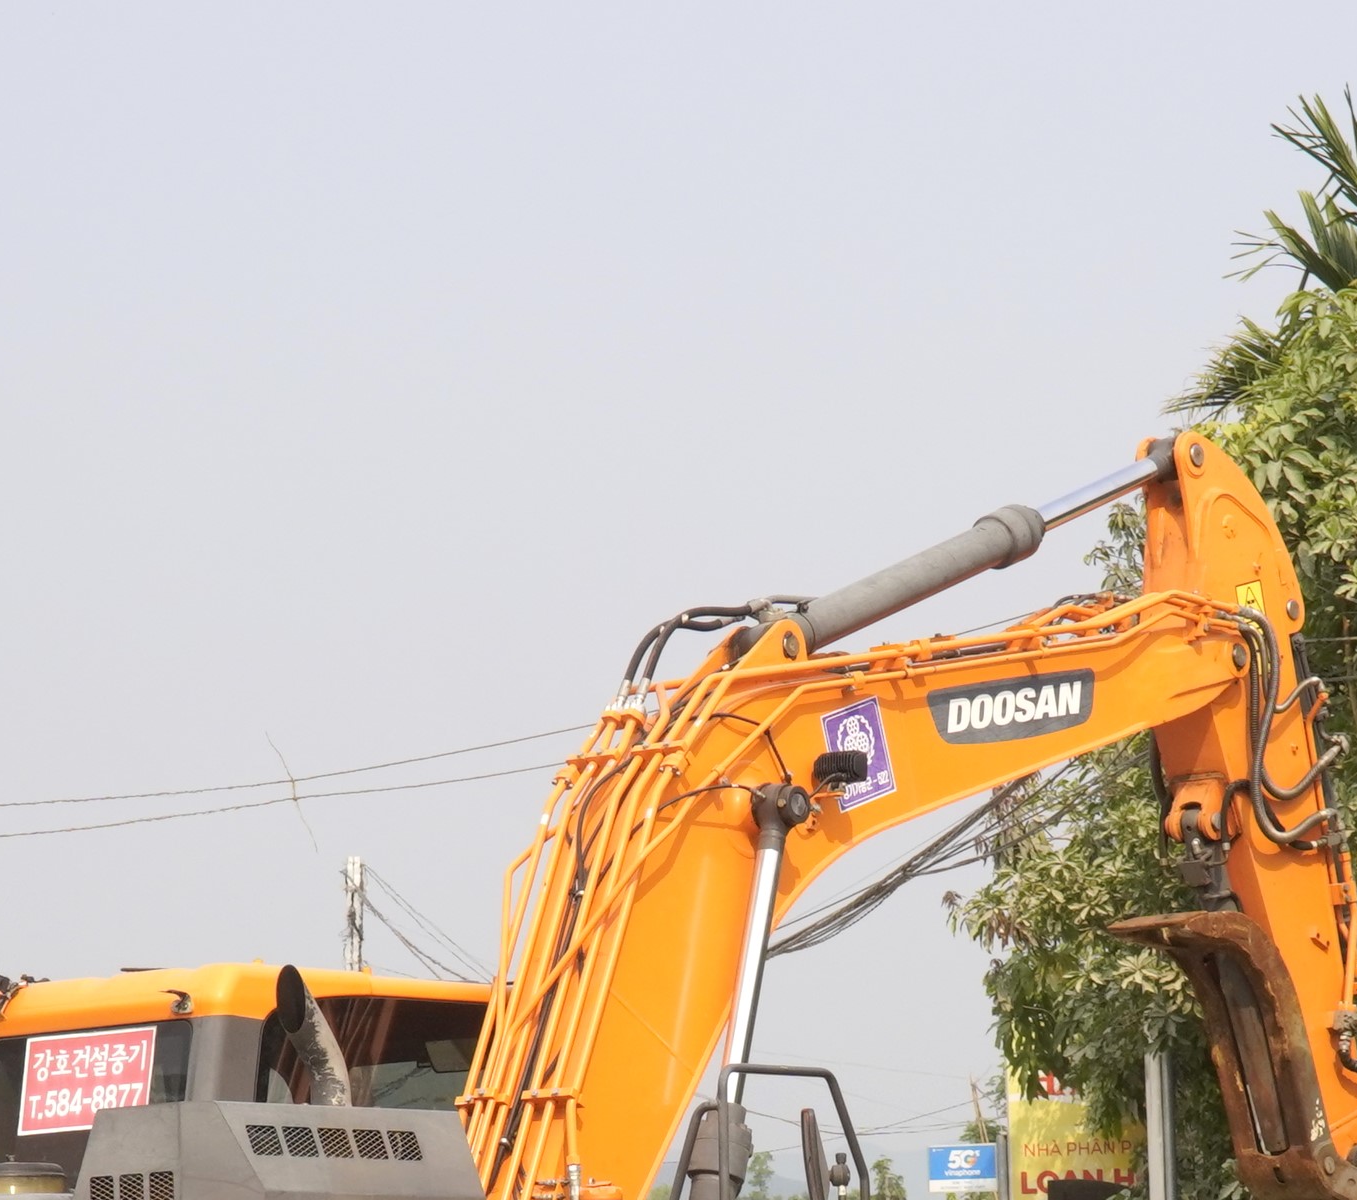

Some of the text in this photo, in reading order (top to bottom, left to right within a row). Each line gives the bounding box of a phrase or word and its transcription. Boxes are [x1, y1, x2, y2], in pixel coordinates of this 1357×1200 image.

[947, 680, 1082, 734] DOOSAN
[33, 1039, 148, 1082] 강호건설중기
[29, 1082, 143, 1120] T.584-8877
[1024, 1139, 1062, 1157] NHÀ
[1066, 1138, 1115, 1156] PHÂN
